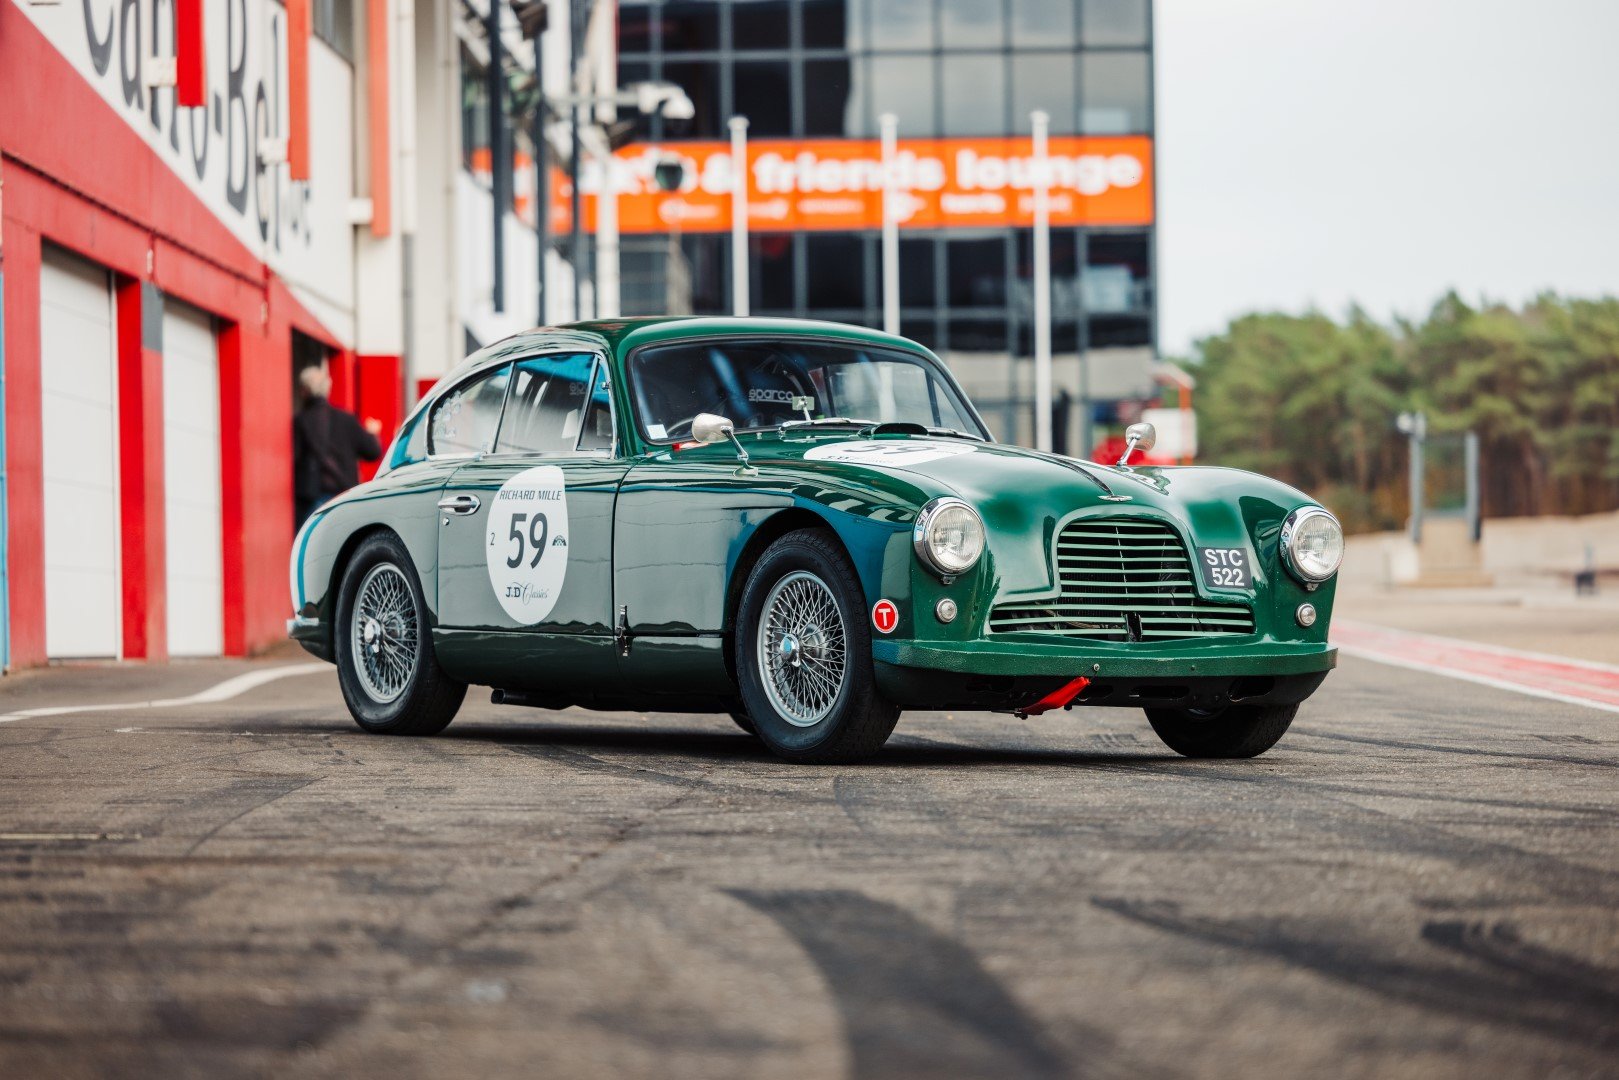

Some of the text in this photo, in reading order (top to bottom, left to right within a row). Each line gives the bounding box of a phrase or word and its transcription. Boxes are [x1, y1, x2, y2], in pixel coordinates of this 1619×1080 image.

[752, 150, 946, 193] friends
[956, 148, 1143, 195] lounge
[749, 388, 794, 402] sparco
[500, 490, 562, 500] RICHARD MILLE
[490, 532, 496, 546] 2
[507, 512, 548, 570] 59
[1204, 548, 1243, 567] STC
[1211, 567, 1245, 586] 522
[878, 608, 891, 627] T
